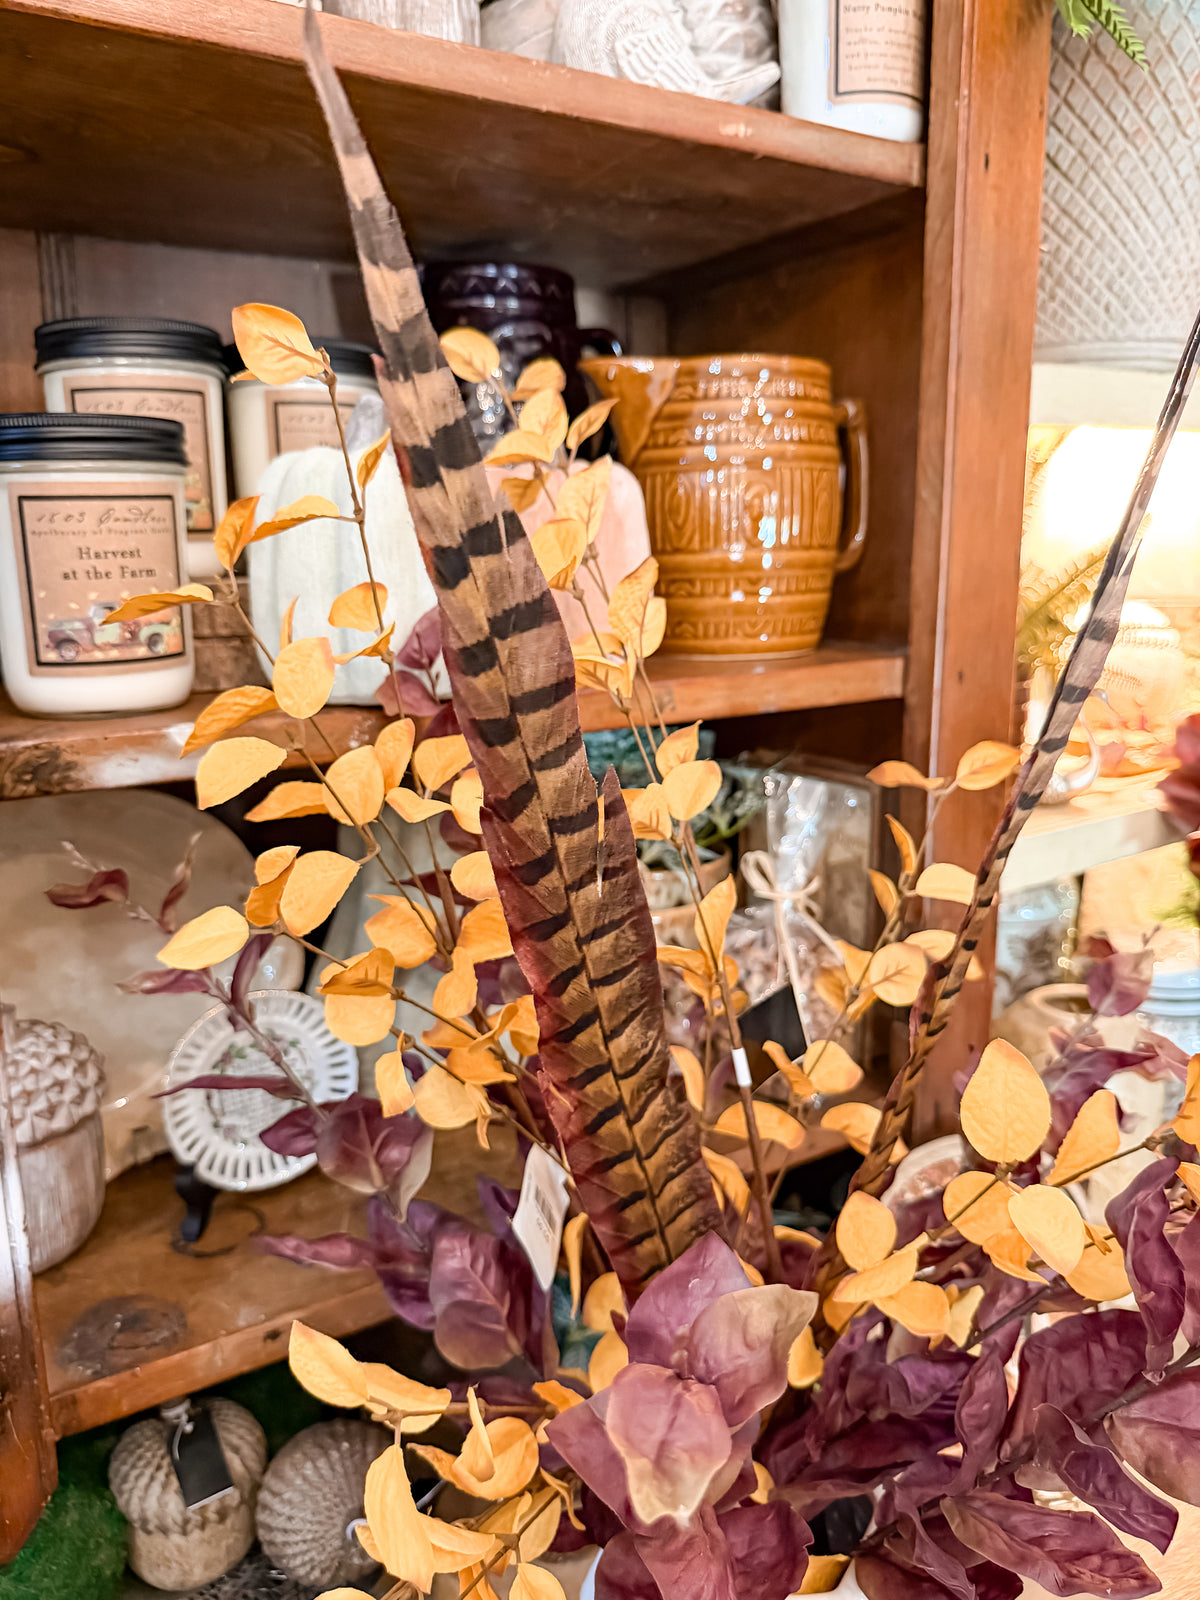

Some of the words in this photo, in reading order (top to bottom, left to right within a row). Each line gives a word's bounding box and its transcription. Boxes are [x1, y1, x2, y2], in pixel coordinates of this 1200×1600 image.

[98, 507, 167, 527] Candles
[77, 546, 143, 561] Harvest
[62, 568, 79, 581] at
[86, 565, 113, 580] the
[119, 564, 158, 579] Farm
